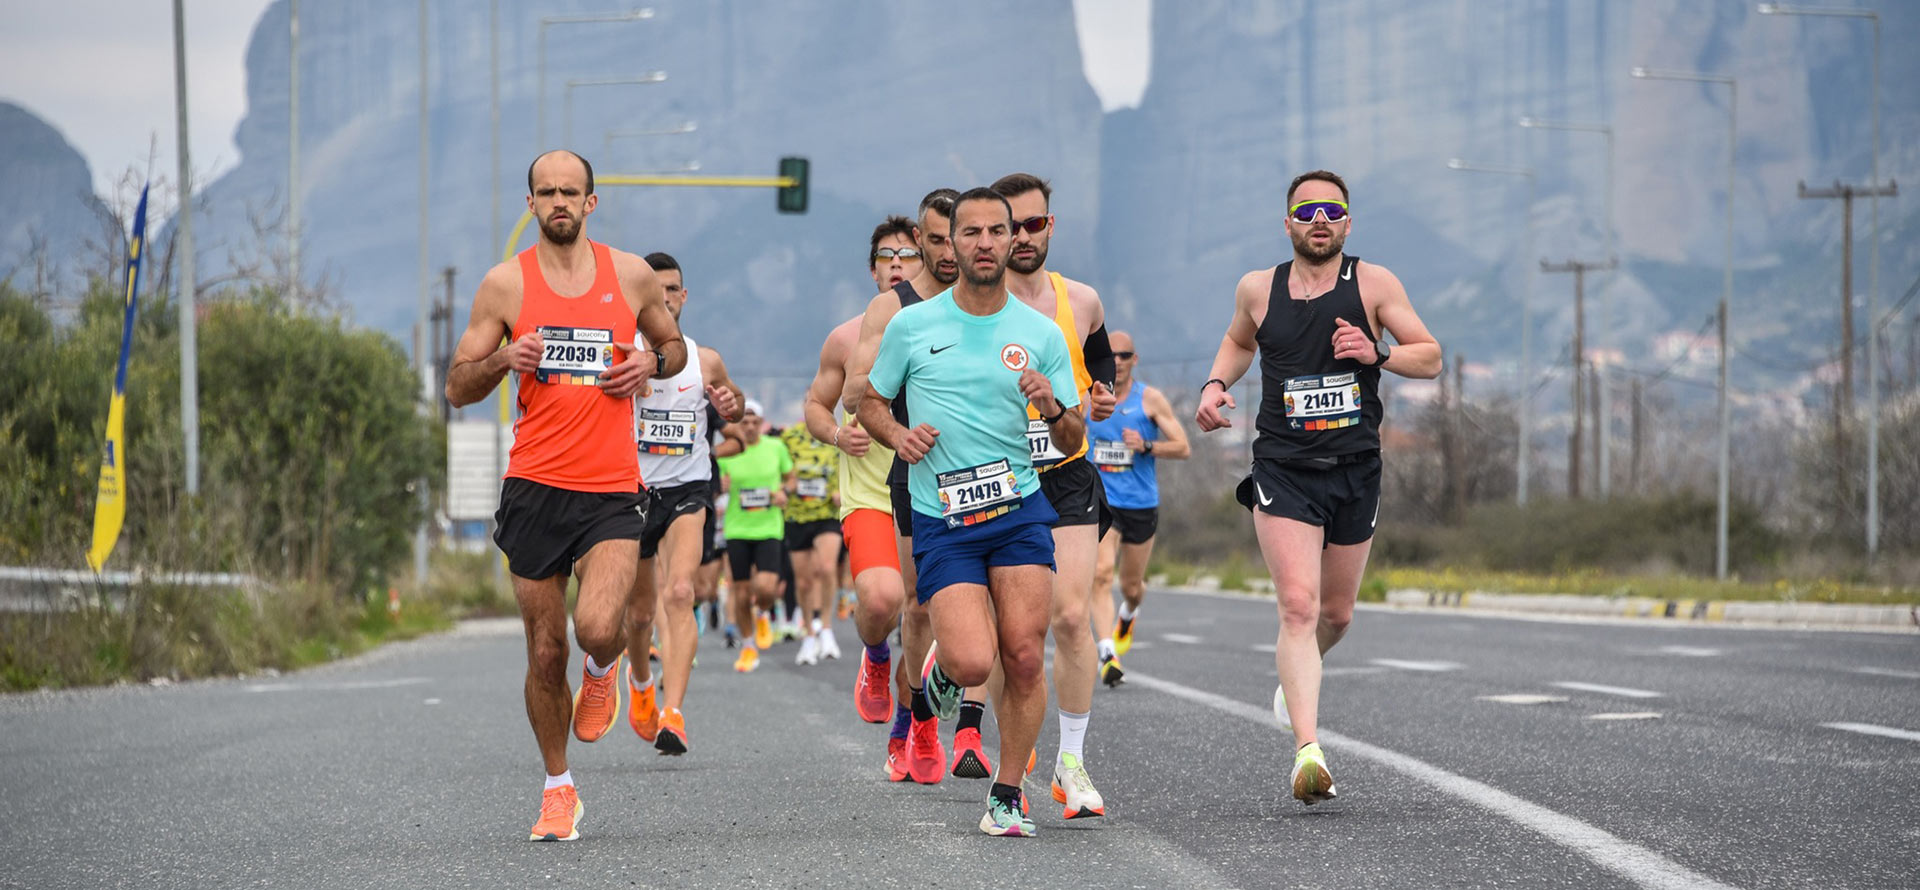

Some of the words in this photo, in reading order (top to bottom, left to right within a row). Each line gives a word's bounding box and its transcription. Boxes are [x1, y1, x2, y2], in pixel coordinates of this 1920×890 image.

[546, 344, 597, 362] 22039
[1304, 391, 1344, 410] 21471
[650, 424, 684, 438] 21579
[957, 481, 1002, 505] 21479
